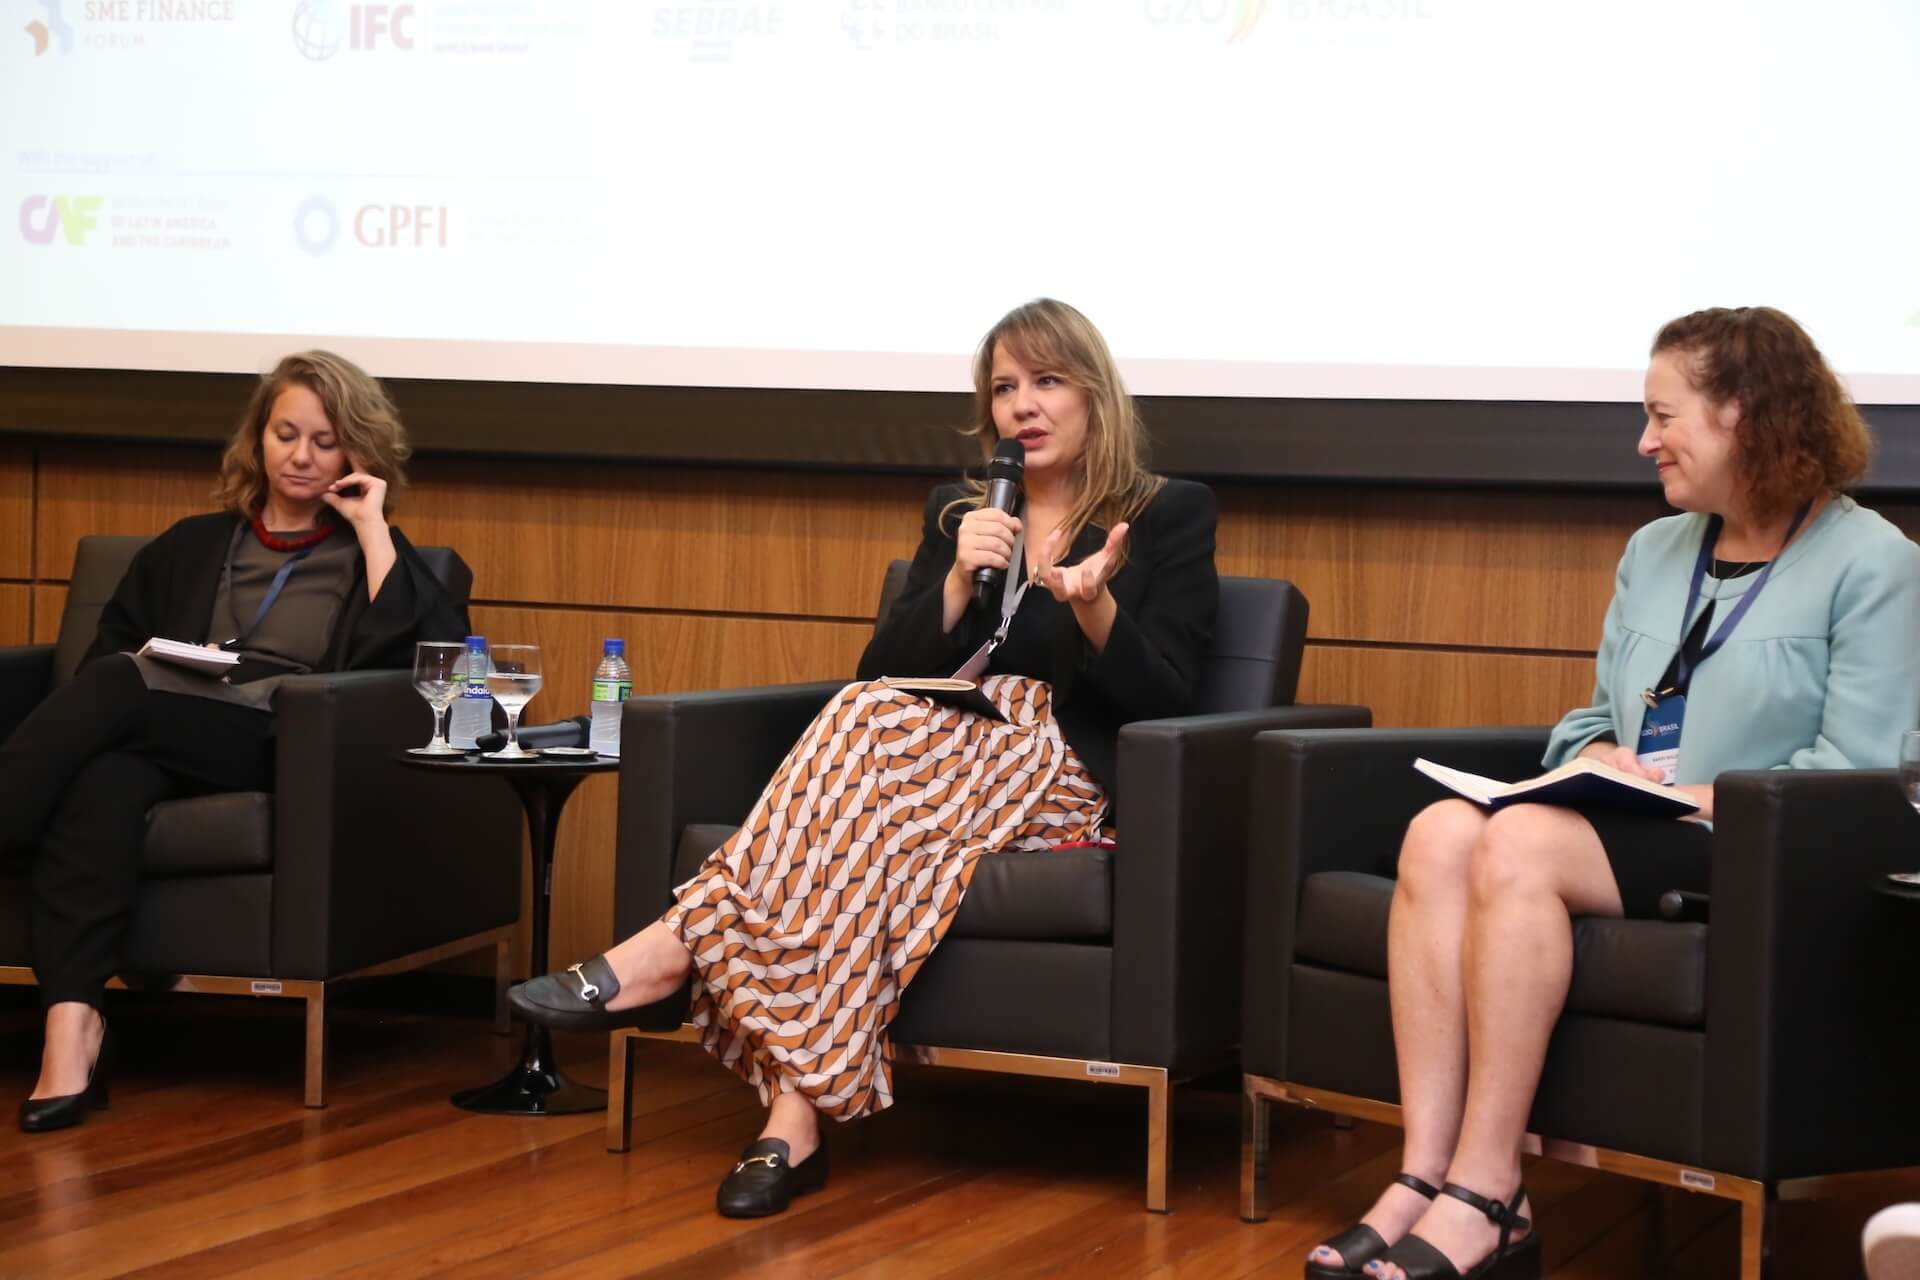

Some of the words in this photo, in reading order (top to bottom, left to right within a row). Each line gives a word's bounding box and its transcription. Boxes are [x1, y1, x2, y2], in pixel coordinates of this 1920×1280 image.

[83, 0, 129, 21] SME
[136, 0, 234, 21] FINANCE
[652, 7, 784, 37] SEBRAE
[1285, 0, 1433, 22] BRASIL
[83, 32, 146, 49] FORUM
[349, 4, 416, 51] IFC
[353, 203, 448, 249] GPFI
